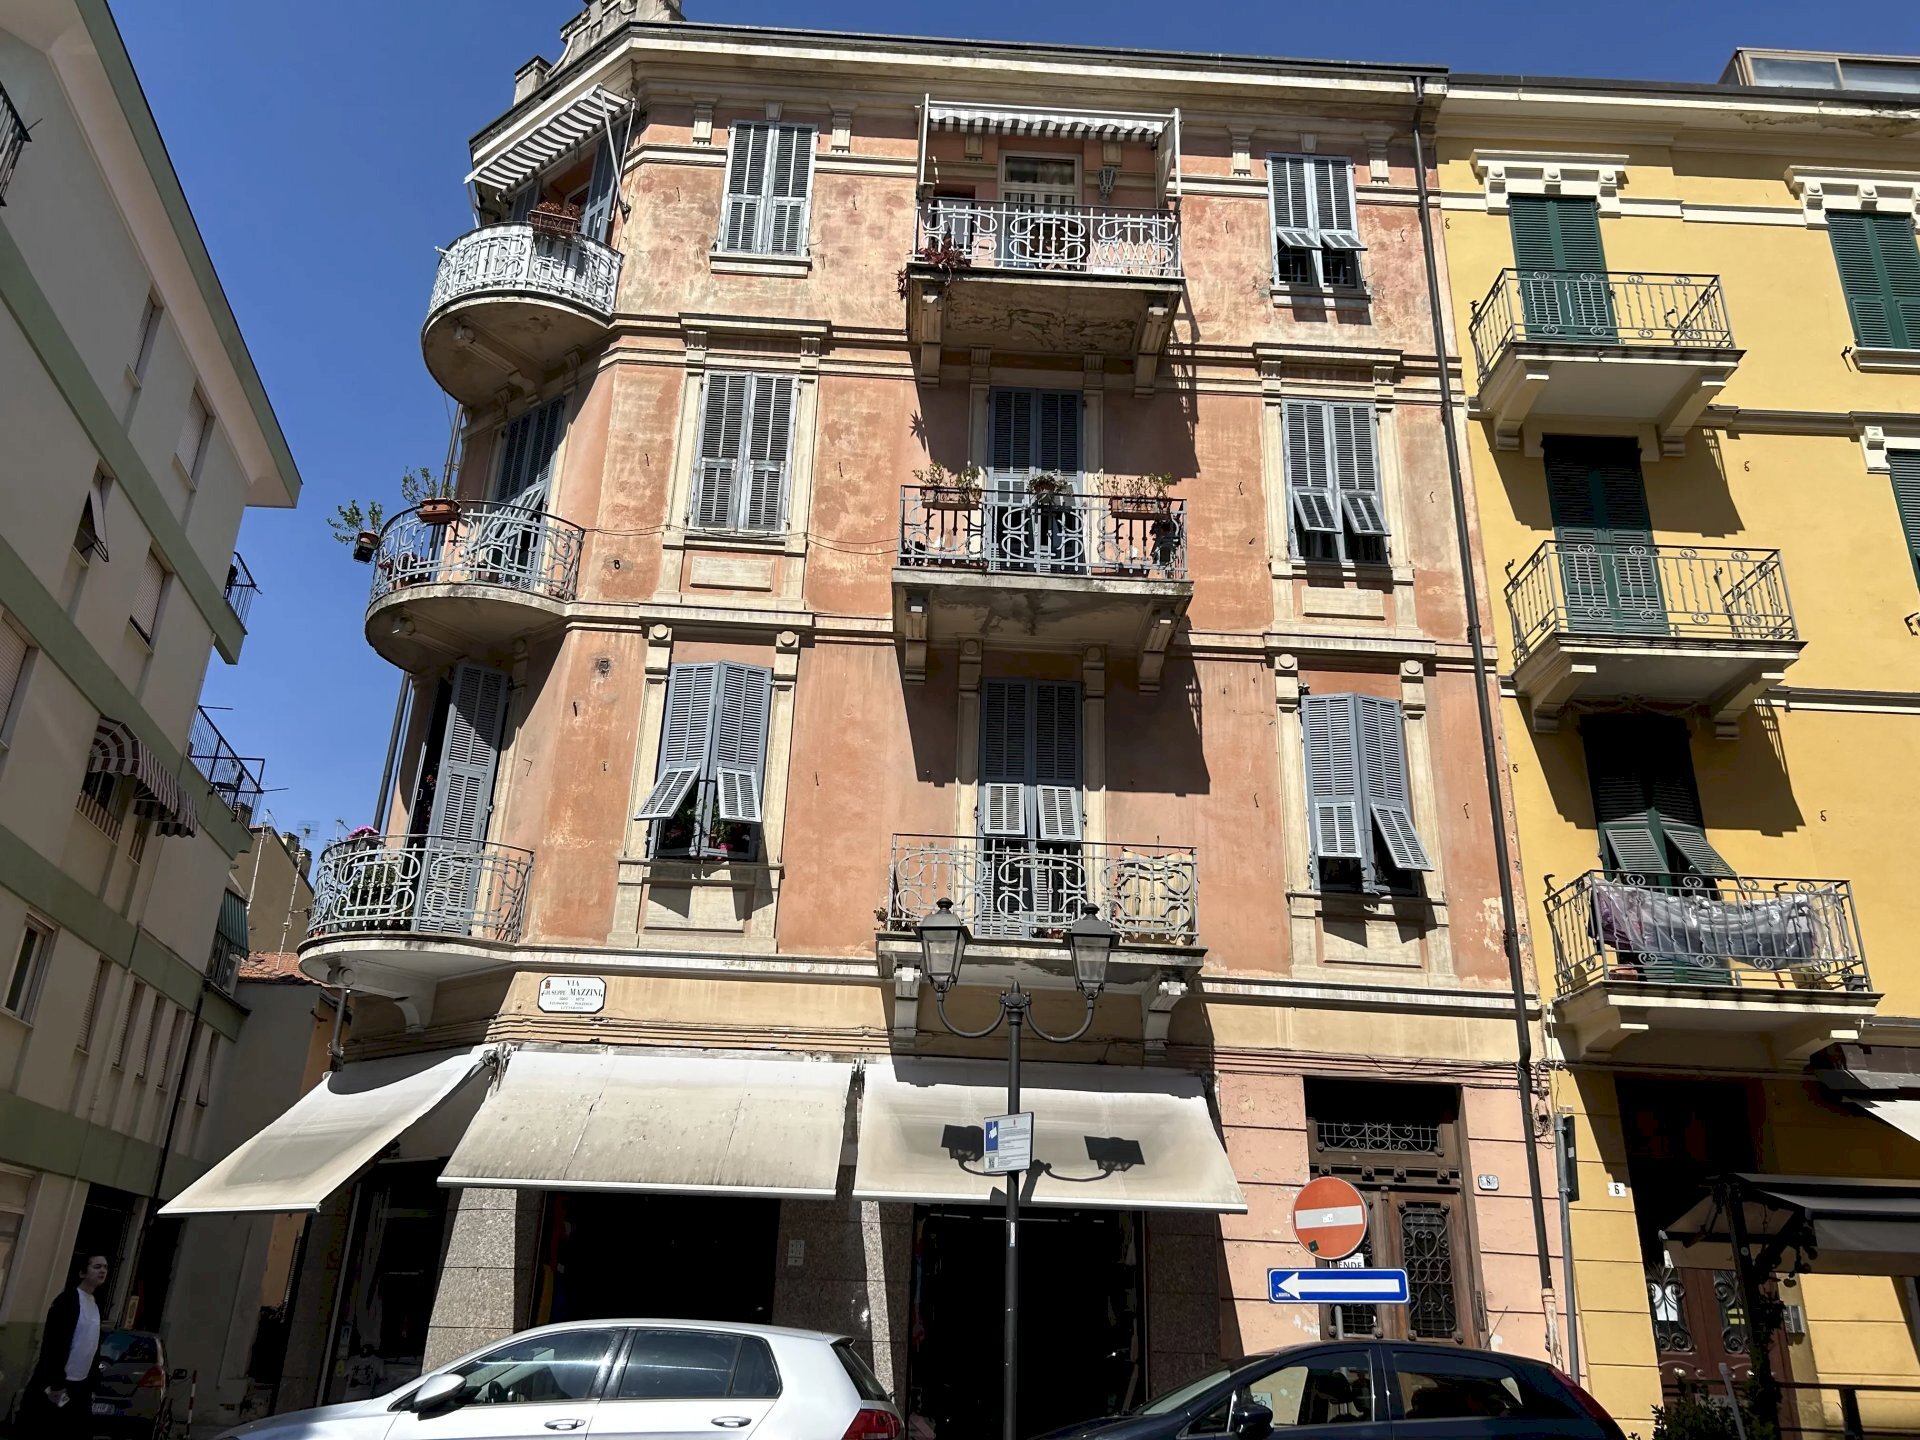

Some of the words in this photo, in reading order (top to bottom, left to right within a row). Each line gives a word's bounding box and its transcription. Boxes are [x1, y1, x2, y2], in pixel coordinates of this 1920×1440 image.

[567, 979, 580, 987] VIA
[570, 988, 602, 997] MAZZINI
[1614, 1184, 1620, 1195] 6
